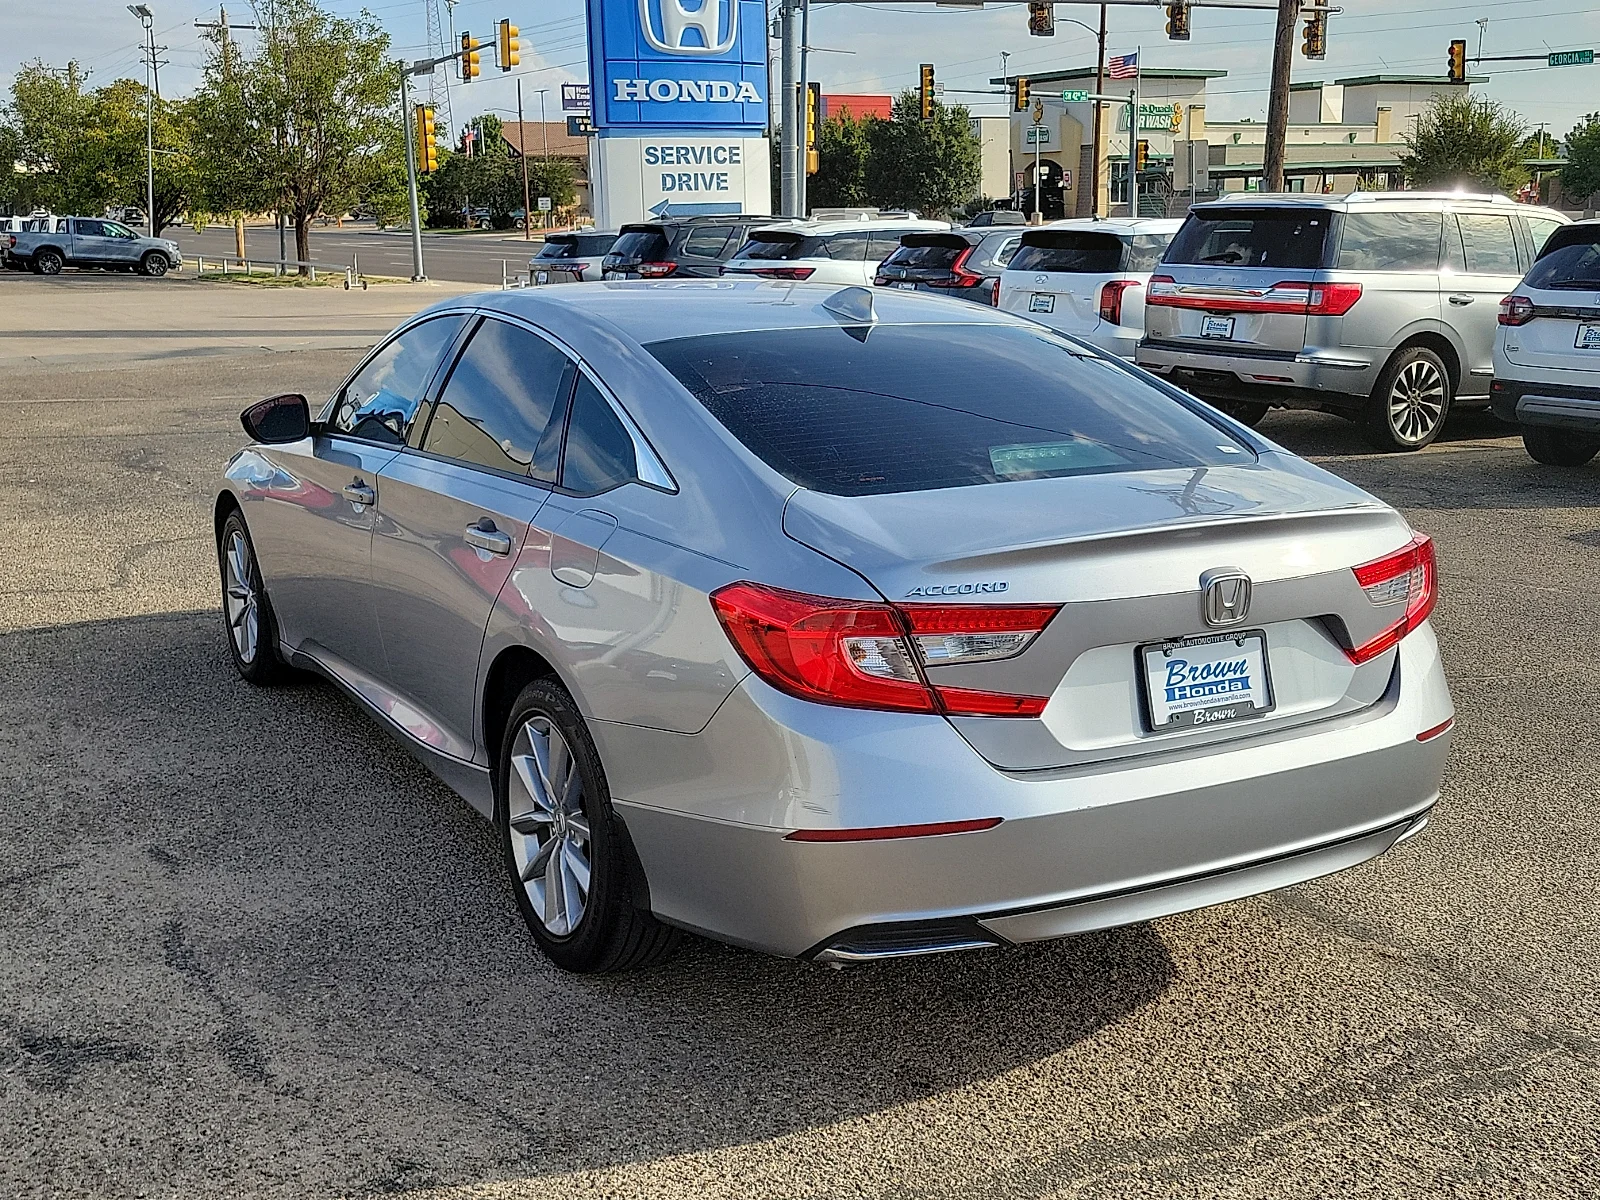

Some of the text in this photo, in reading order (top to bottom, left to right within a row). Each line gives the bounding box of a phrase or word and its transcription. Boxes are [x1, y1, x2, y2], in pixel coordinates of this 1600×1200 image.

[1550, 53, 1580, 65] GEORGIA
[613, 79, 763, 103] HONDA
[1145, 115, 1171, 128] WASH
[644, 146, 741, 165] SERVICE
[661, 172, 729, 192] DRIVE
[904, 580, 1010, 598] ACCORD
[1162, 632, 1247, 651] BROWN AUTOMOTIVE GROUP
[1165, 658, 1249, 687] Brown
[1174, 680, 1243, 700] Honda
[1168, 692, 1251, 710] www.brownhondaamarillo.com
[1193, 708, 1238, 725] Brown
